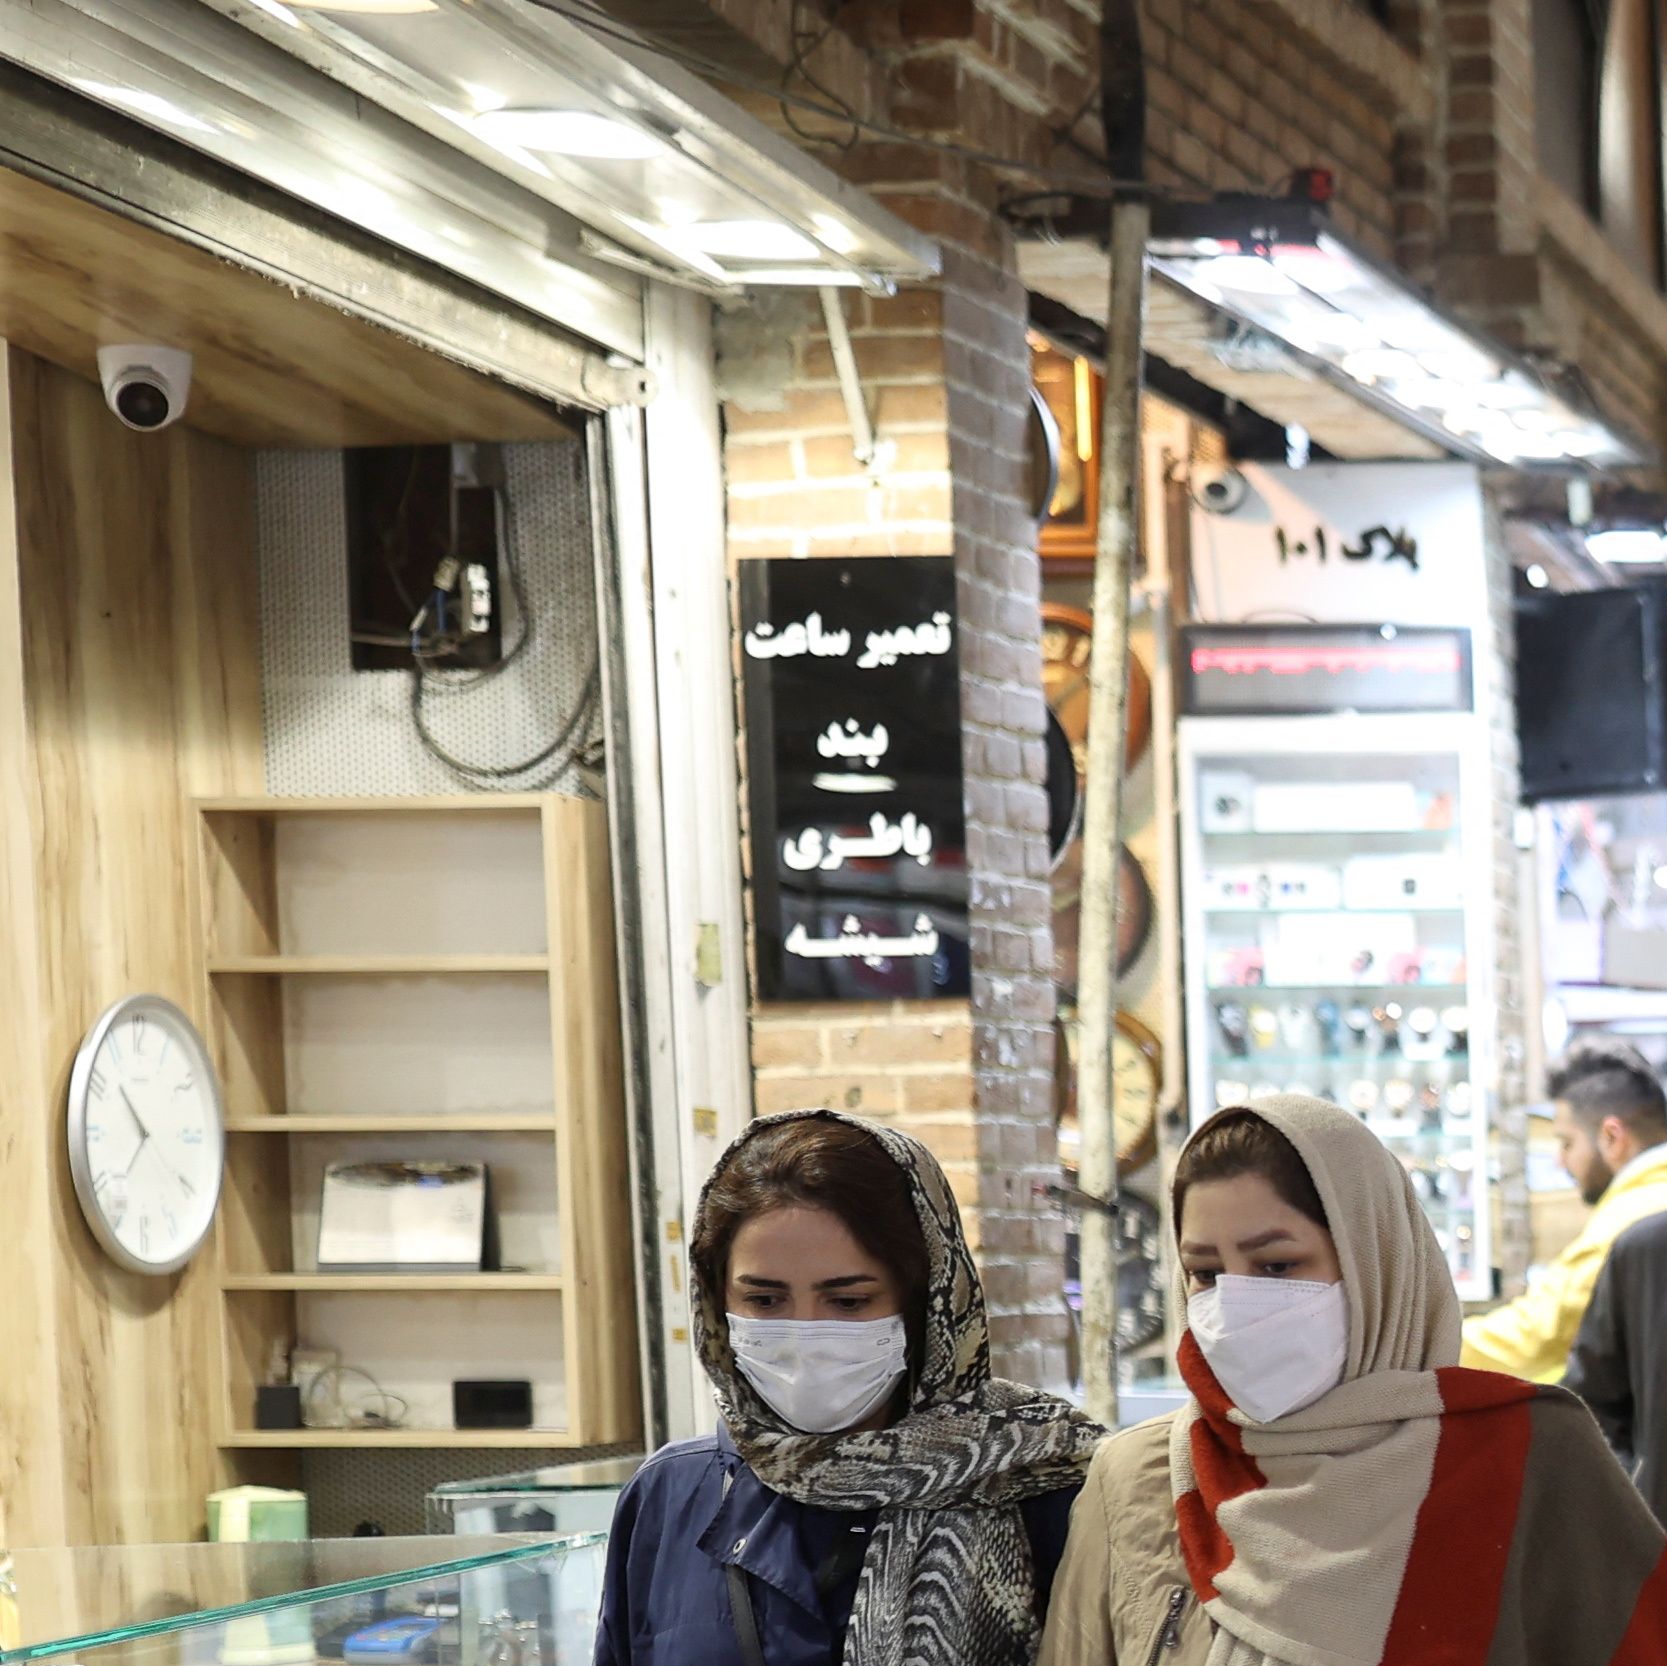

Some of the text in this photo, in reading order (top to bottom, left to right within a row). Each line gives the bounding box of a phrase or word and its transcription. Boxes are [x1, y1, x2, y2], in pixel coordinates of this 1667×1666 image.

[1341, 525, 1420, 572] پلاک
[744, 610, 952, 669] تعمیر ساعت
[816, 716, 890, 768] بند
[783, 810, 933, 871] باطری
[784, 912, 940, 968] شیشه
